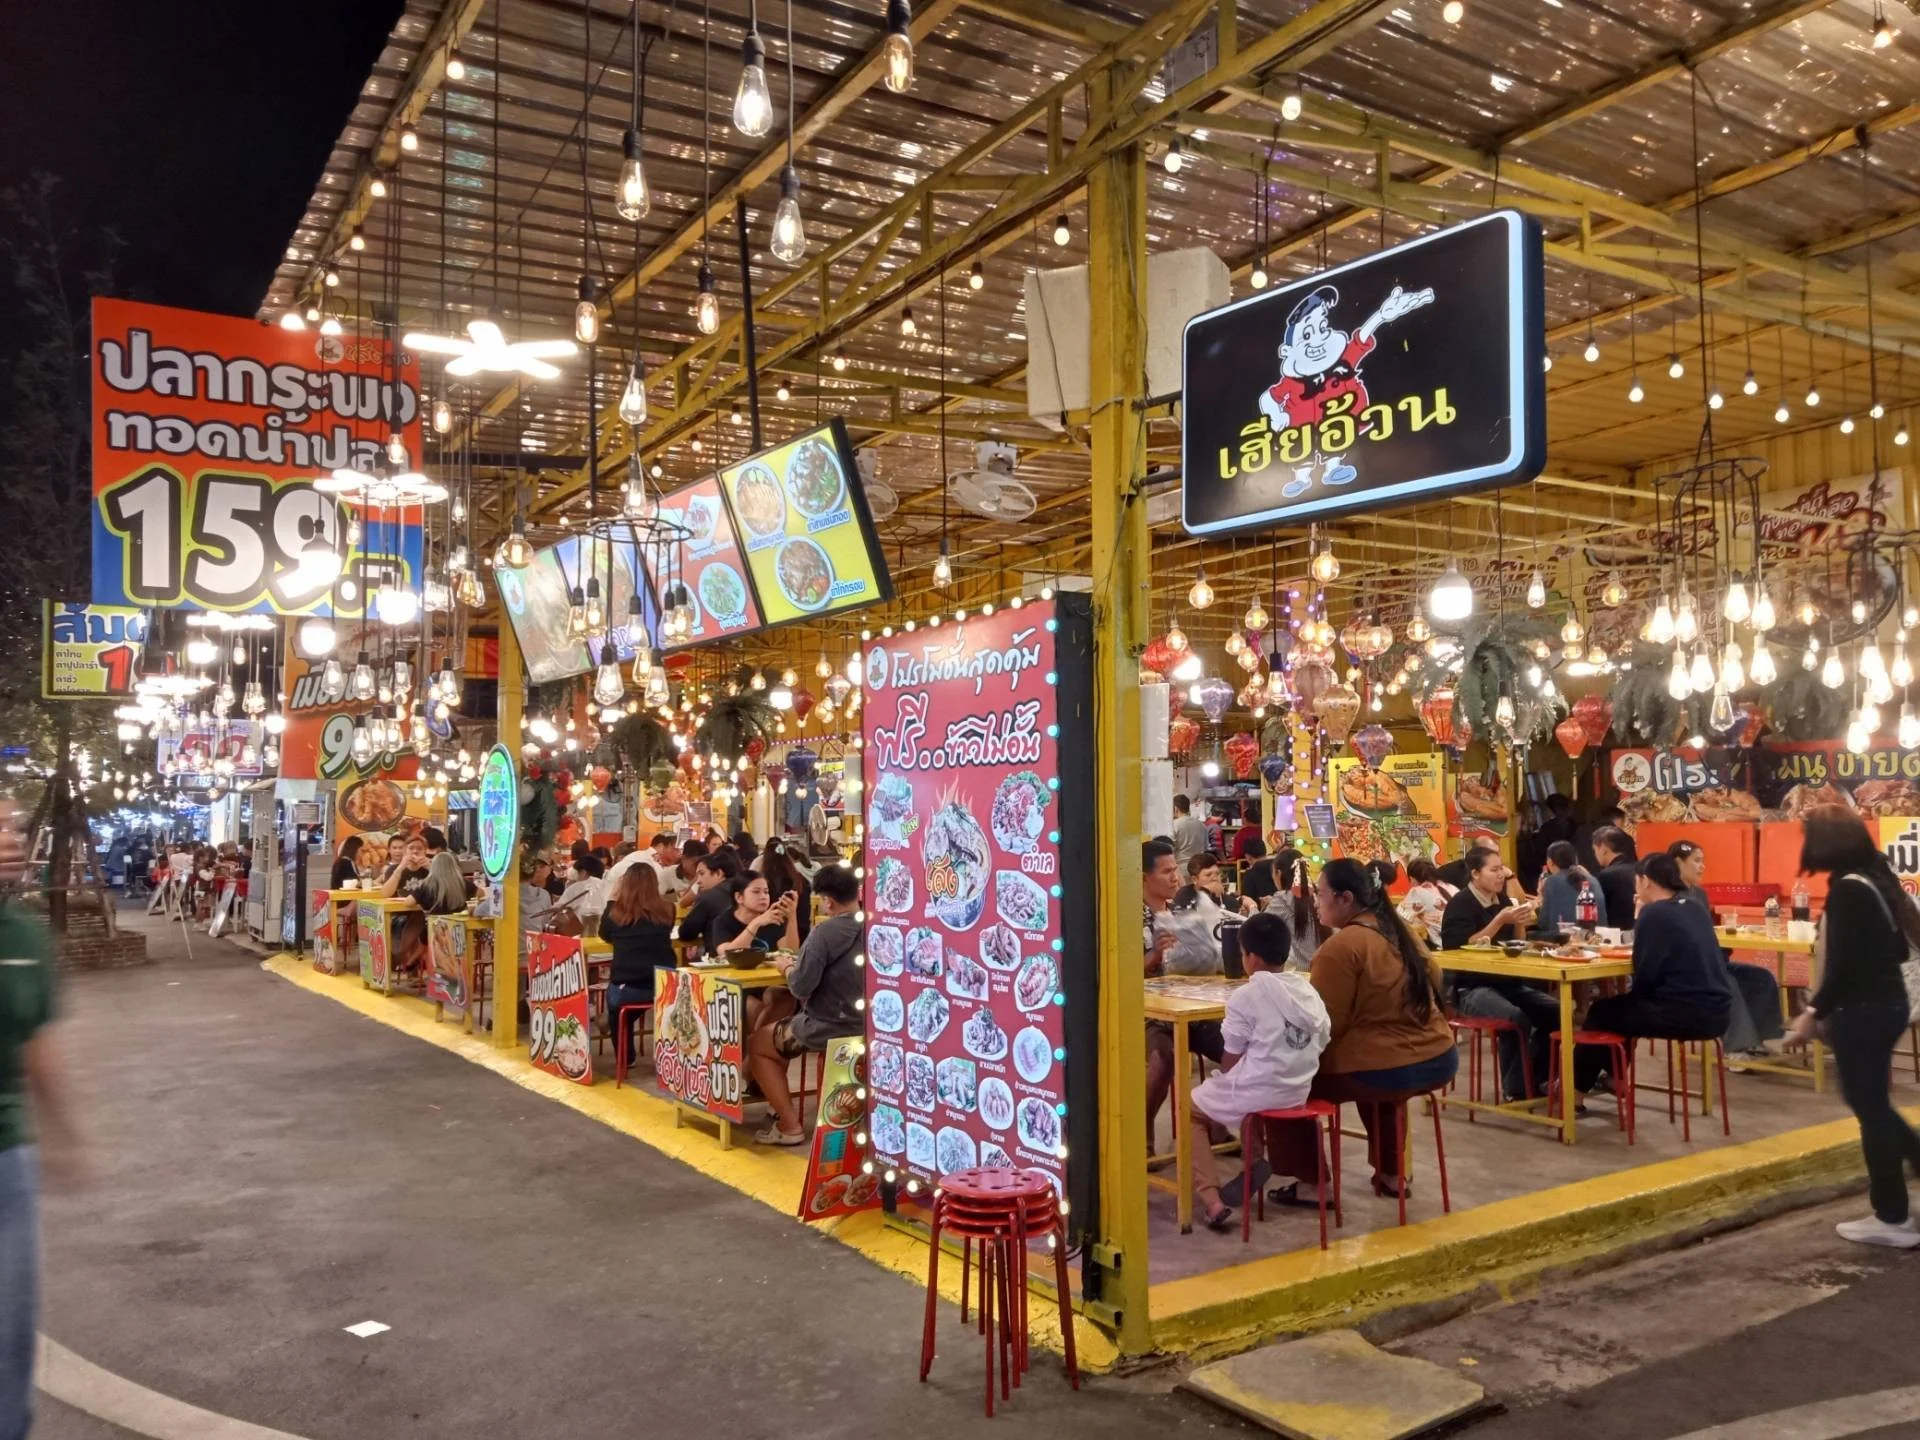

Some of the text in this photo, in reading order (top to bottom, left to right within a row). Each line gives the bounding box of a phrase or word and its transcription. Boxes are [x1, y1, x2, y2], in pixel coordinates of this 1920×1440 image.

[1218, 387, 1457, 480] เฮียอ้วน
[890, 627, 1042, 696] โปรโมชั่นสุดคุ้ม
[925, 852, 959, 897] เล้ง
[1021, 843, 1055, 874] ตำเล
[711, 1042, 740, 1103] ข้าว
